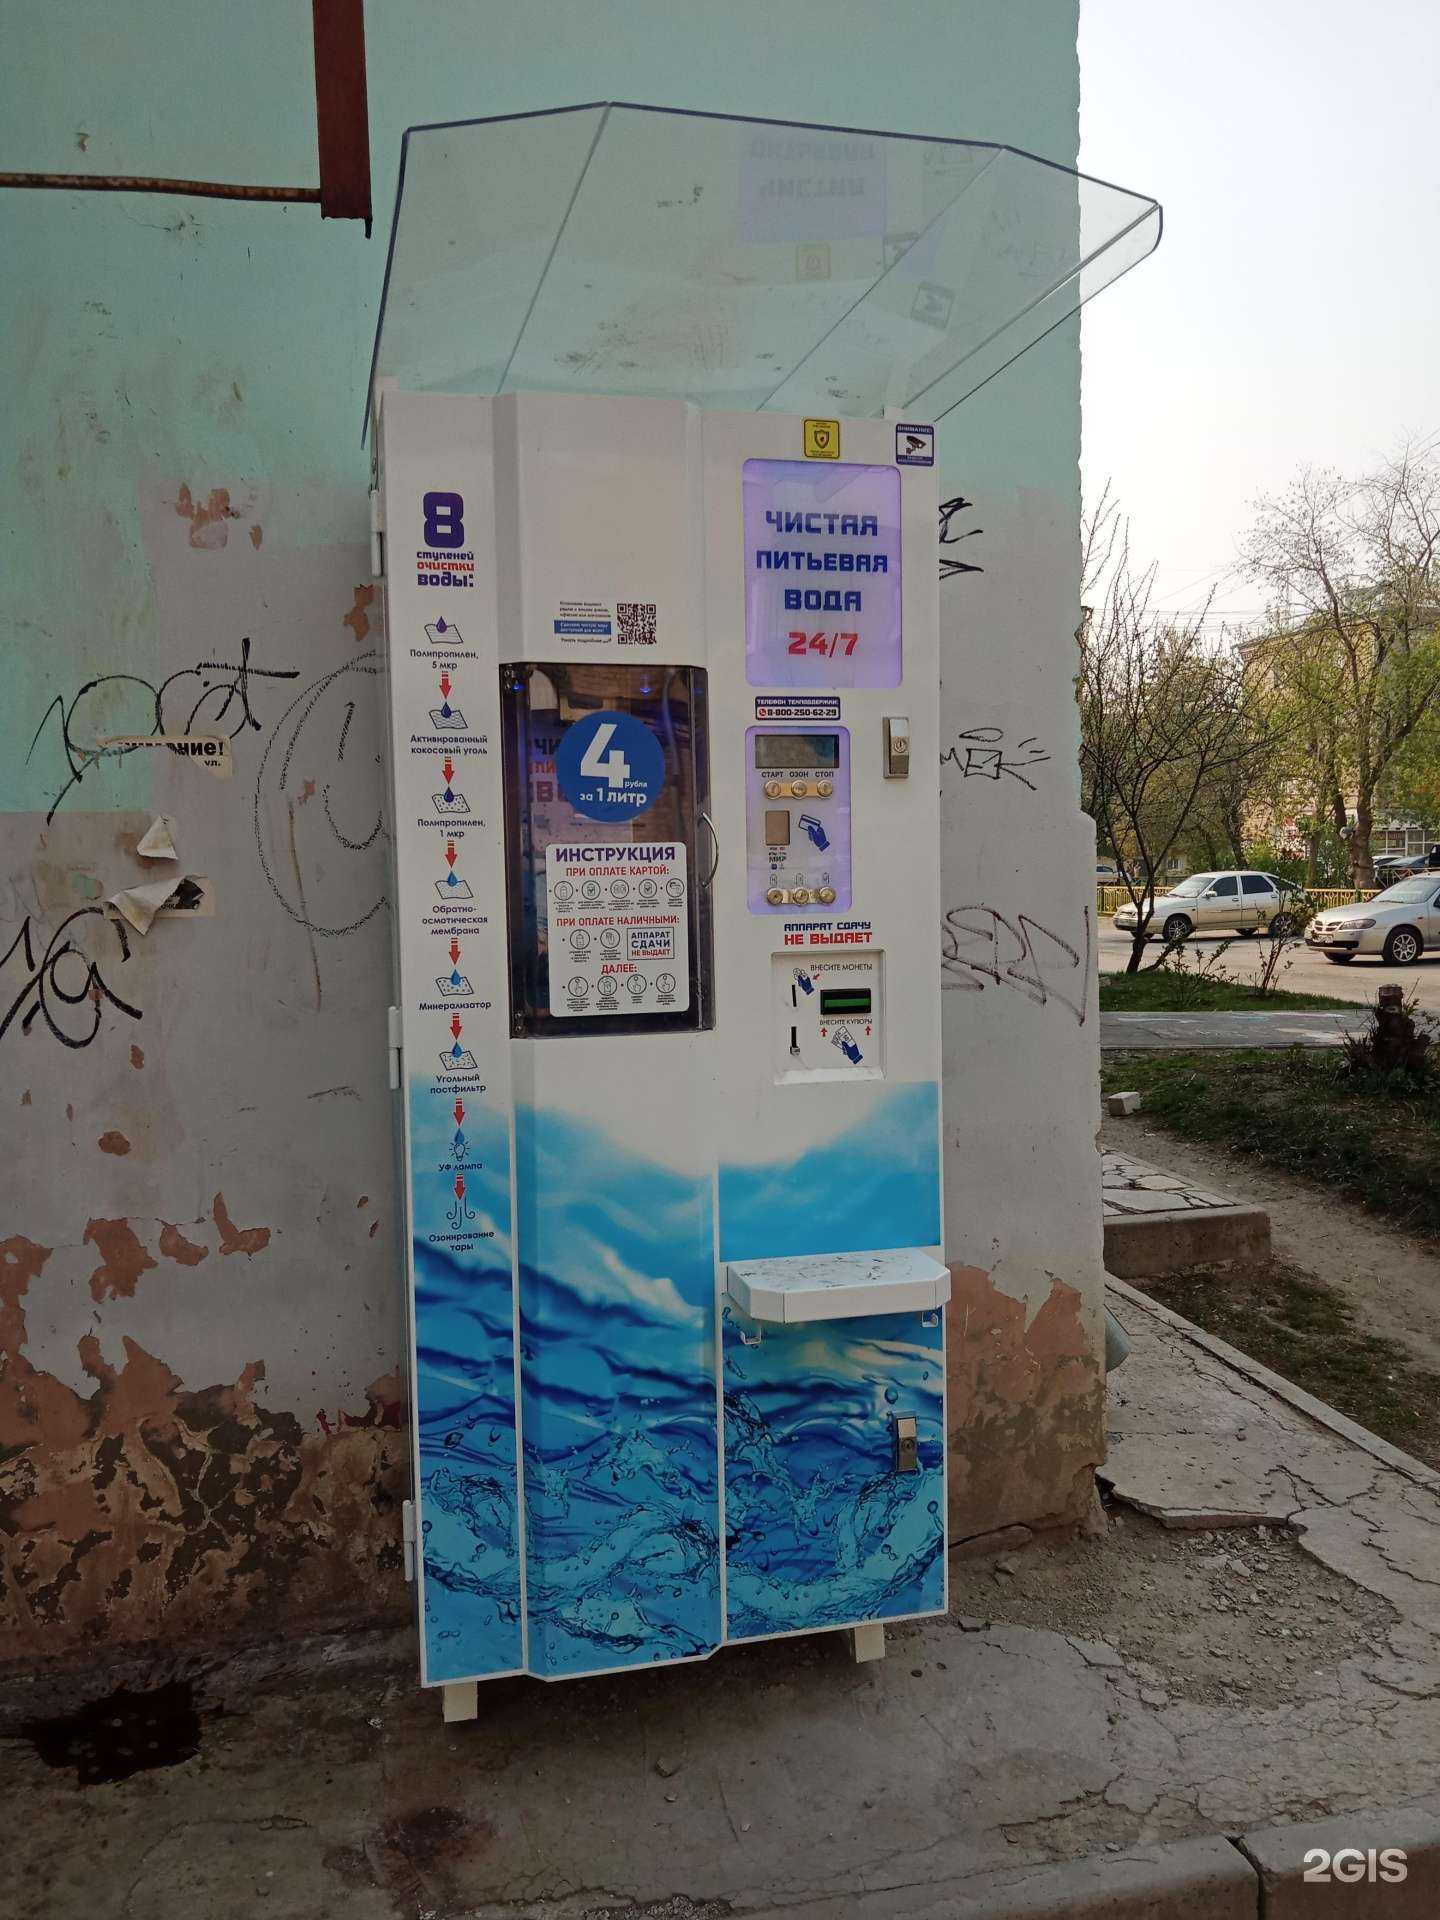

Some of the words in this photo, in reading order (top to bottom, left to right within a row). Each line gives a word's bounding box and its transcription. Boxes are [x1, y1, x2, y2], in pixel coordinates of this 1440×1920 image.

[423, 492, 464, 548] 8
[766, 510, 878, 537] ЧИСТАЯ
[416, 551, 474, 561] ступеней
[416, 561, 475, 571] очистки
[756, 550, 888, 573] ПИТЬЕВАЯ
[417, 571, 474, 587] воды:
[784, 589, 861, 611] ВОДА
[788, 631, 858, 657] 24/7
[410, 649, 479, 660] Полипропилен,
[432, 661, 437, 669] 5
[440, 662, 458, 671] мкр
[410, 735, 488, 745] Активированный
[411, 746, 461, 755] кокосовый
[580, 723, 630, 788] 4
[624, 781, 648, 789] рубля
[761, 771, 784, 779] СТАРТ
[789, 771, 809, 779] ОЗОН
[815, 771, 834, 779] СТОП
[580, 793, 593, 801] за
[597, 788, 603, 801] 1
[607, 792, 647, 807] литр
[417, 819, 486, 828] Полипропилен,
[446, 831, 465, 839] мкр
[556, 847, 675, 863] ИНСТРУКЦИЯ
[566, 868, 585, 877] ПРИ
[589, 867, 626, 876] ОПЛАТЕ
[630, 864, 669, 875] КАРТОЙ:
[432, 905, 477, 914] Обратно-
[556, 918, 576, 927] ПРИ
[578, 917, 613, 926] ОПЛАТЕ
[617, 915, 680, 925] НАЛИЧНЫМИ:
[430, 926, 480, 936] мембрана
[784, 923, 832, 931] АППАРАТ
[837, 922, 871, 930] СДАЧУ
[784, 934, 804, 945] НЕ
[810, 932, 873, 944] ВЫДАЕТ
[631, 940, 670, 949] СДАЧИ
[601, 964, 637, 974] ДАЛЕЕ:
[419, 1001, 492, 1012] Минерализатор
[436, 1073, 480, 1083] Угольный
[430, 1085, 486, 1096] постфильтр
[453, 1163, 483, 1171] лампа
[428, 1231, 495, 1243] Озонирование
[450, 1244, 474, 1253] тары
